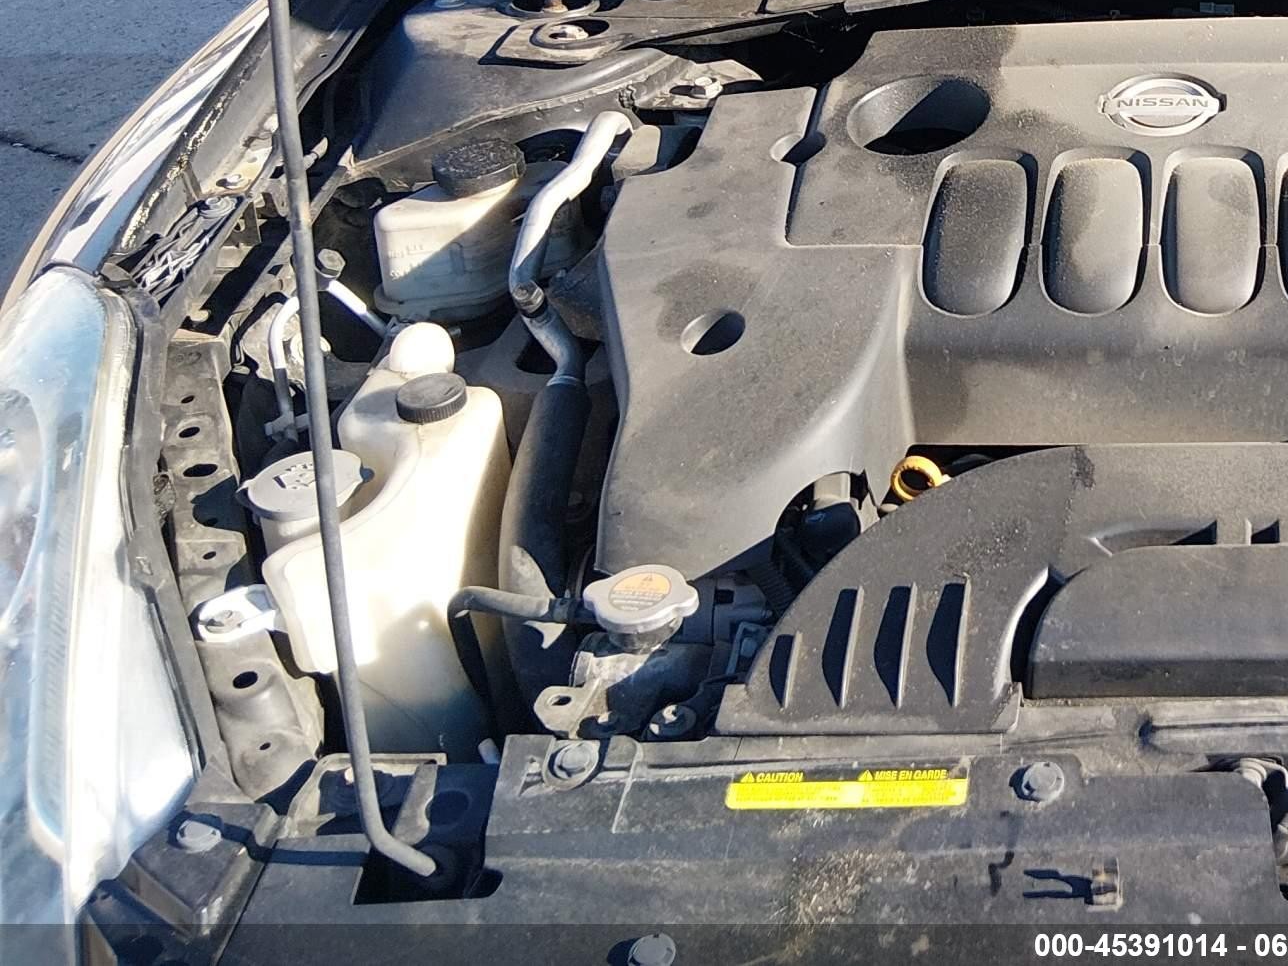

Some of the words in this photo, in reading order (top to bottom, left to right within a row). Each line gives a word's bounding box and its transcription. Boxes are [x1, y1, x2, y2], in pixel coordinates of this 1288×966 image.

[1117, 97, 1209, 108] NISSAN
[755, 771, 804, 783] CAUTION
[874, 770, 898, 781] MISE
[898, 770, 913, 781] EN
[913, 769, 948, 780] GARDE
